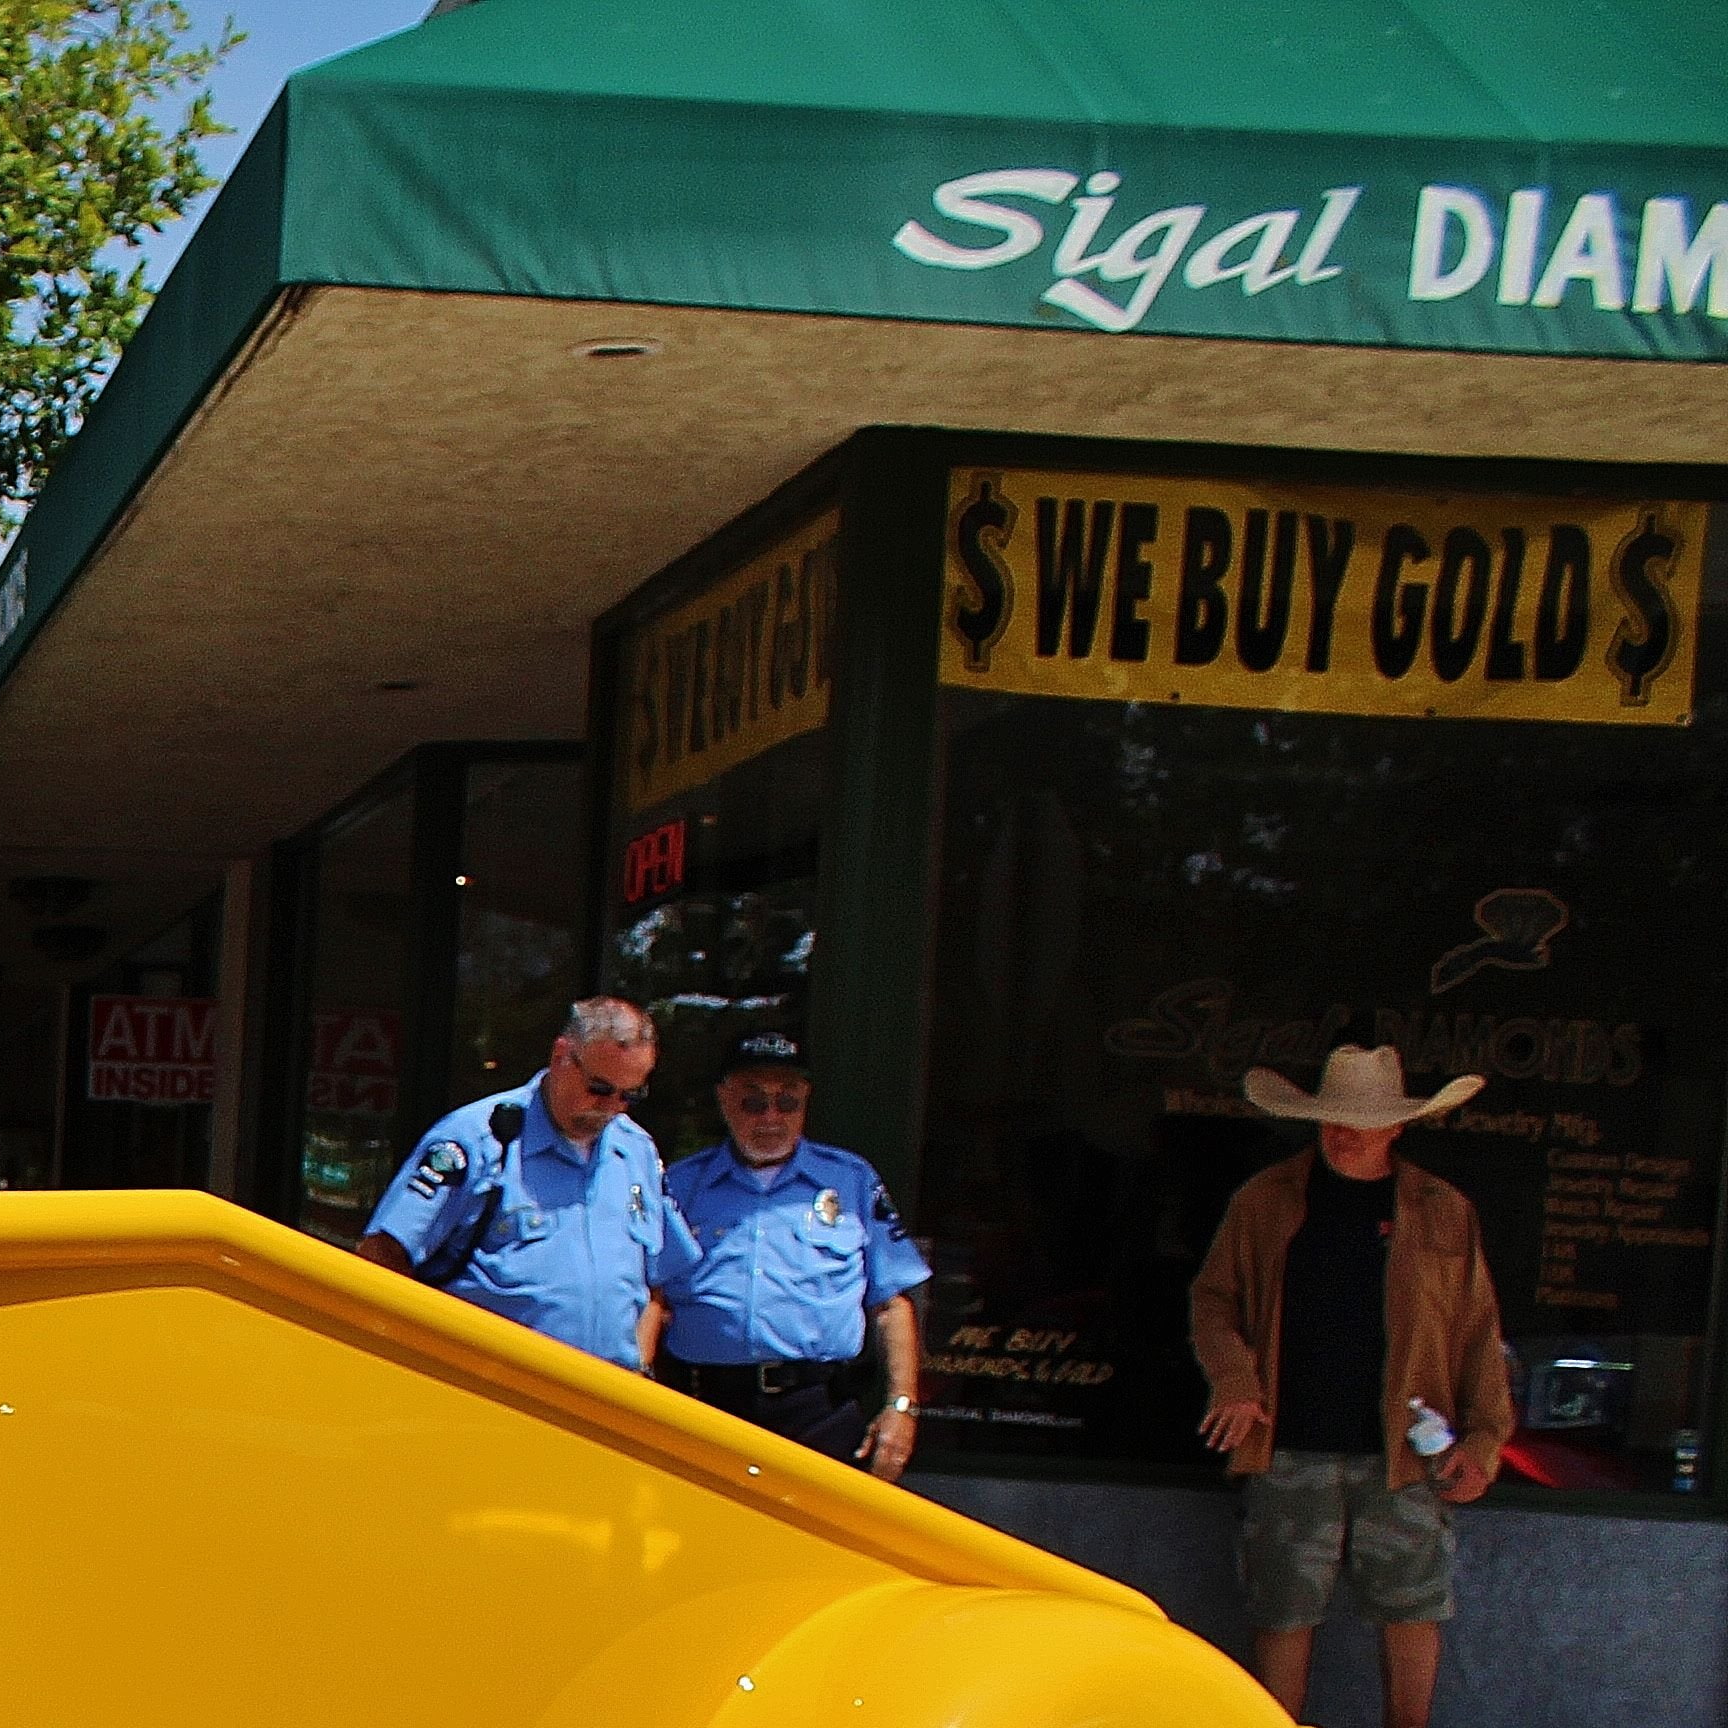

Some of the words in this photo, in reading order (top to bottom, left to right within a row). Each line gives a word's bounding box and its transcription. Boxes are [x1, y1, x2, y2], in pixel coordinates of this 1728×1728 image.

[893, 168, 1363, 333] Sigal
[1407, 184, 1728, 319] DIAM
[1034, 494, 1160, 662] WE
[1173, 504, 1358, 675] BUY
[1369, 522, 1594, 684] GOLD
[624, 820, 686, 904] OPEN
[96, 1002, 218, 1060] ATM
[93, 1065, 216, 1100] INSIDE
